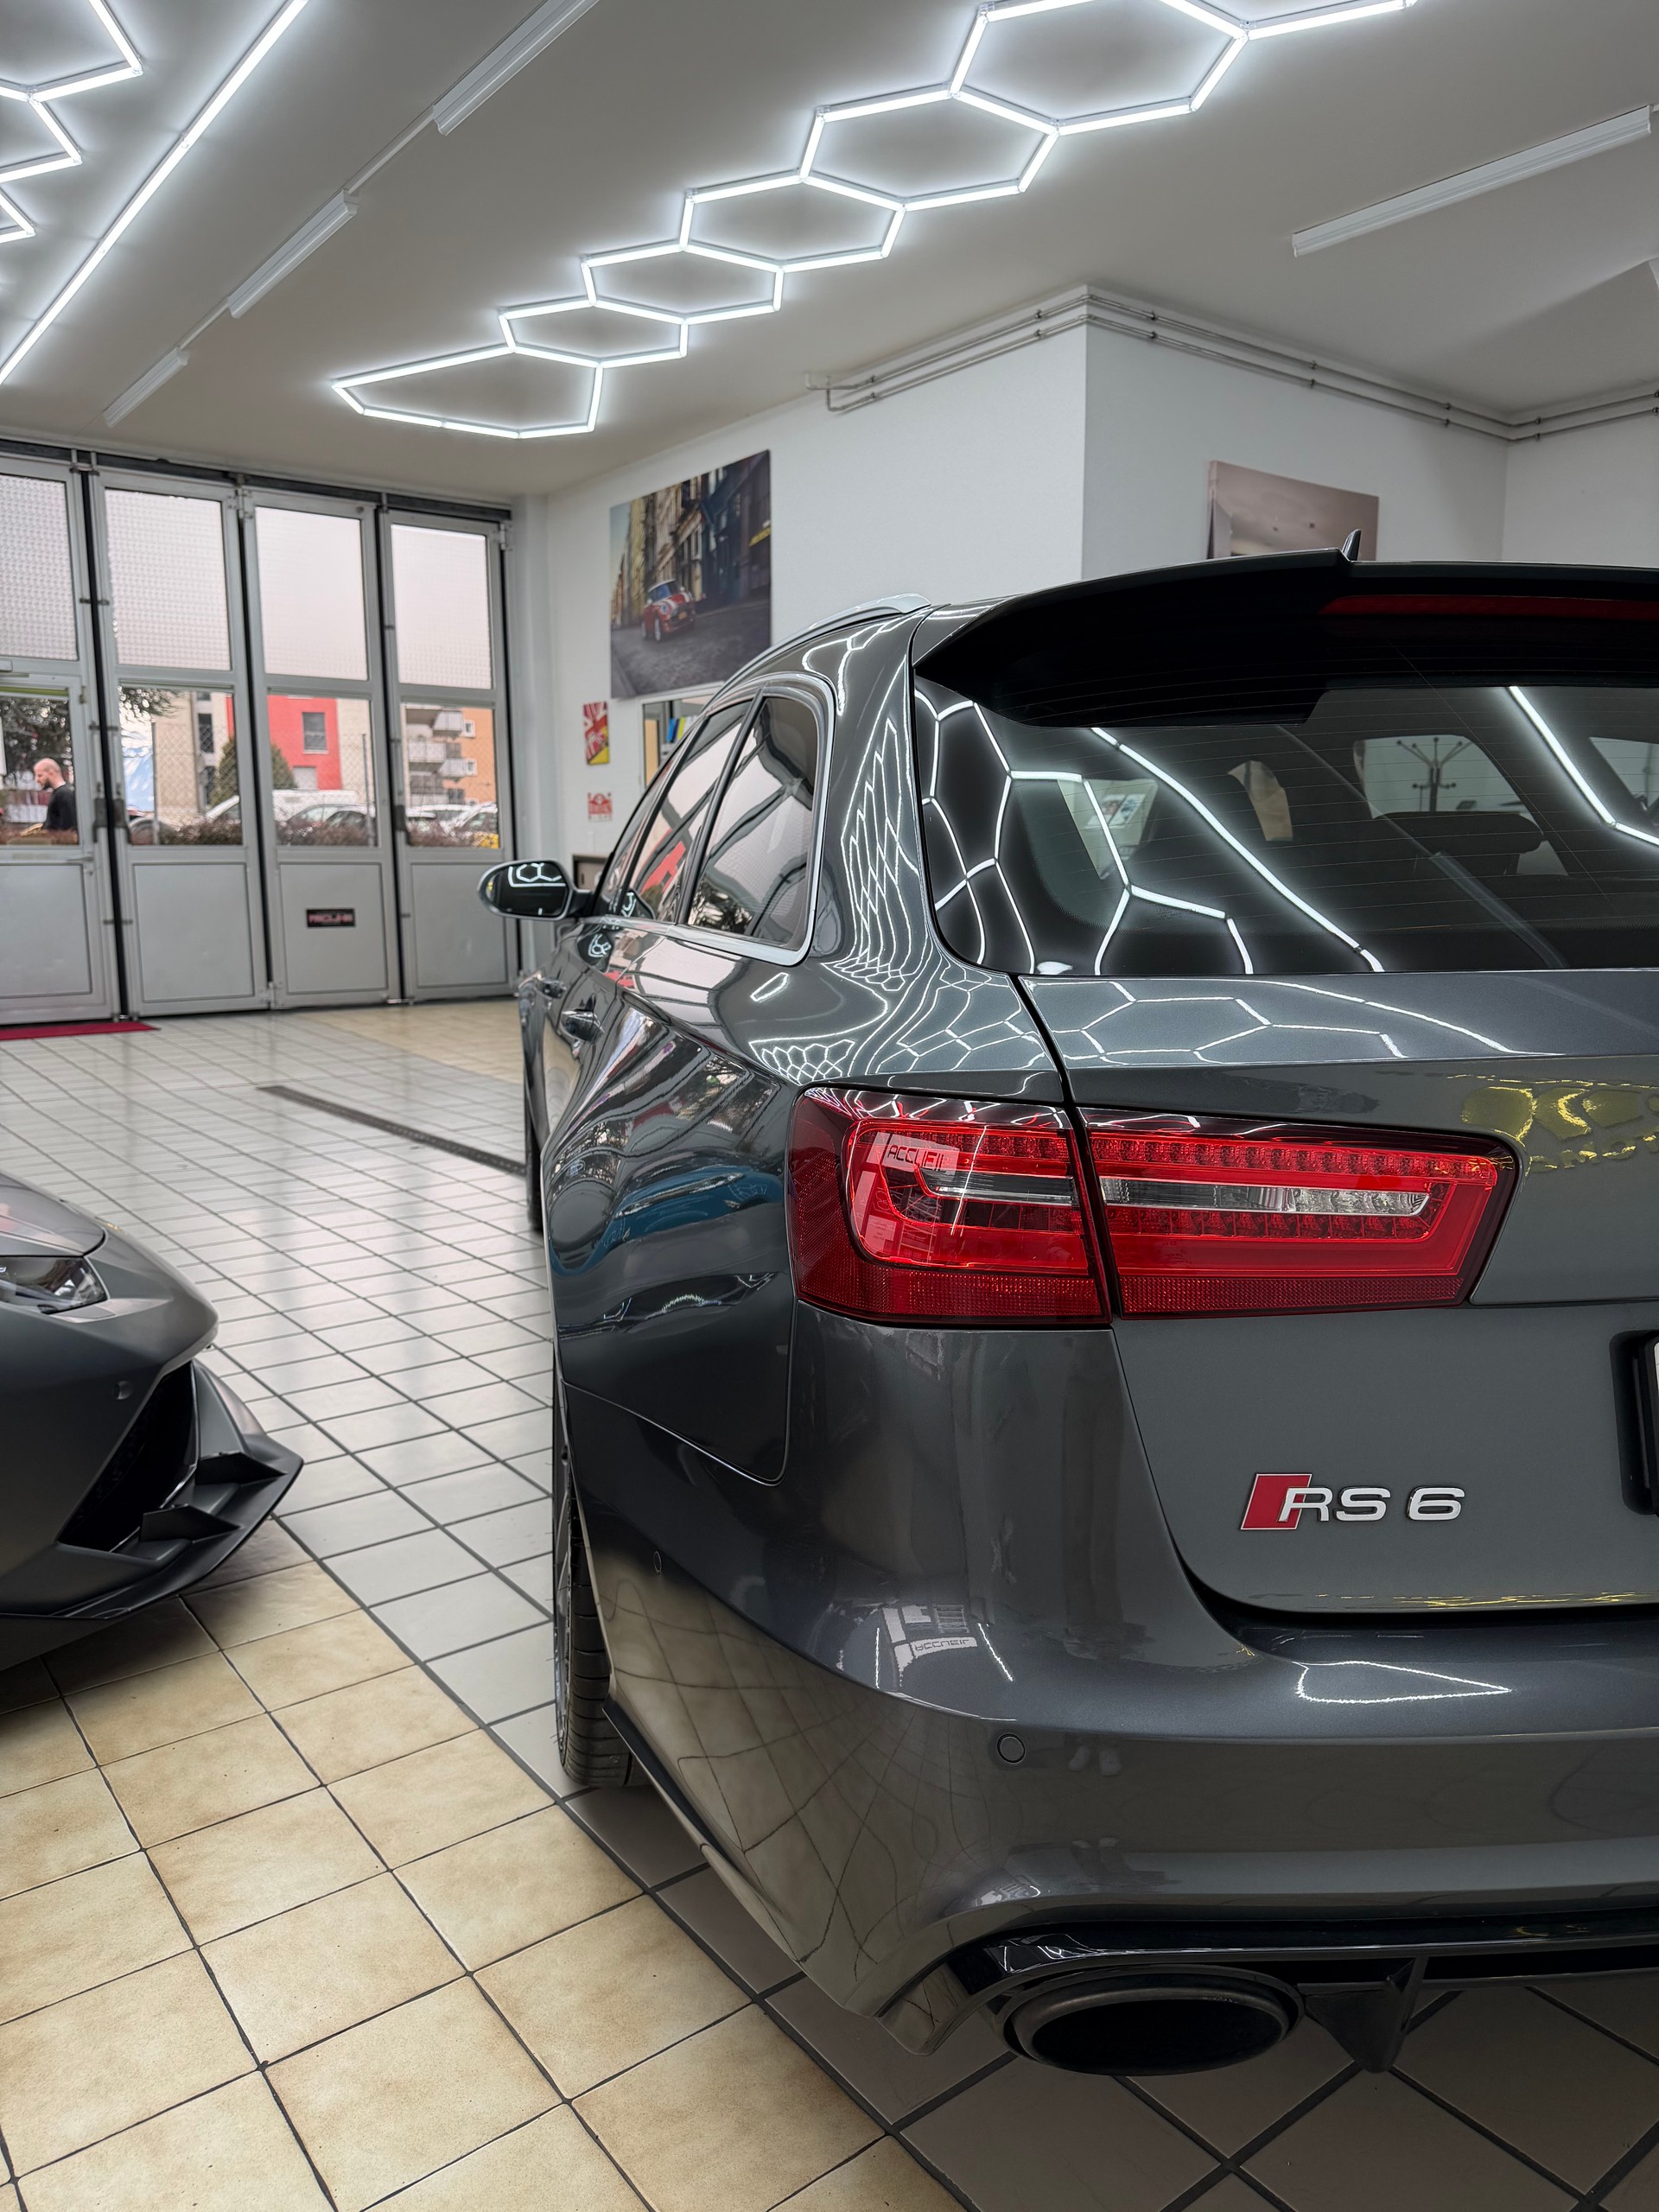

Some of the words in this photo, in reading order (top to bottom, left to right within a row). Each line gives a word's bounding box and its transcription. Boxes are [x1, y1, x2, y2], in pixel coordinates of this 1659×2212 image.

[887, 1144, 947, 1173] ACCUEIL
[1277, 1486, 1391, 1522] RS
[1408, 1486, 1465, 1521] 6
